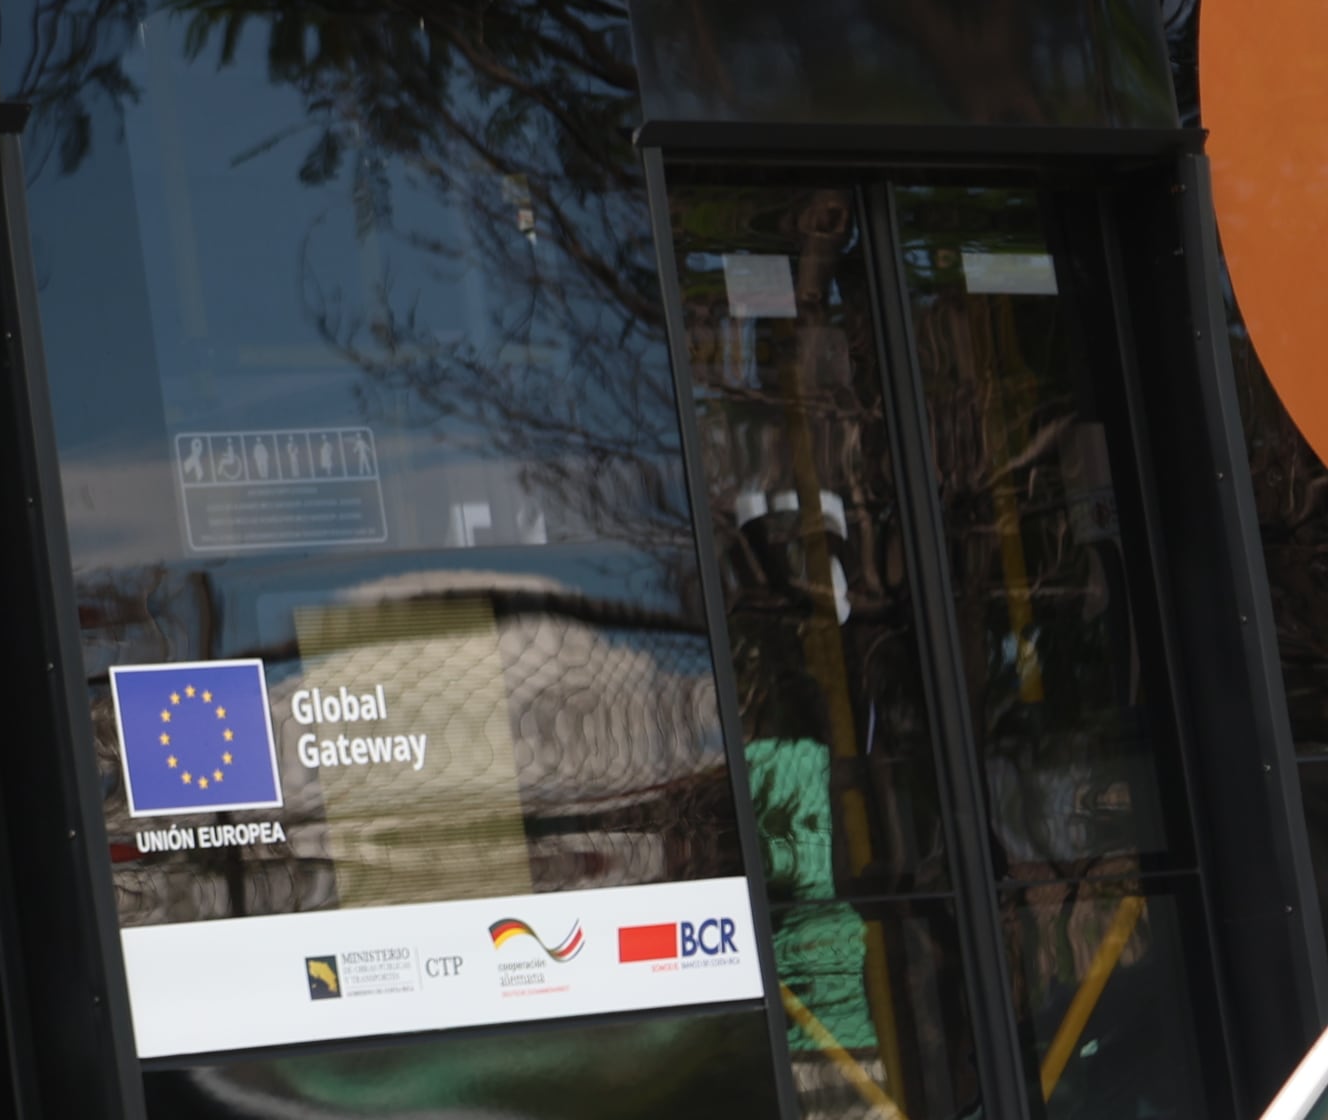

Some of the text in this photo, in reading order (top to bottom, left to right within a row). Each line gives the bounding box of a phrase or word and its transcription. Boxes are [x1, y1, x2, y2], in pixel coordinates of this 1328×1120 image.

[291, 684, 387, 725] Global
[297, 732, 427, 772] Gateway
[136, 821, 286, 853] UNIÓN EUROPEA
[681, 917, 739, 957] BCR
[342, 947, 411, 965] MINISTERIO
[425, 955, 464, 978] CTP
